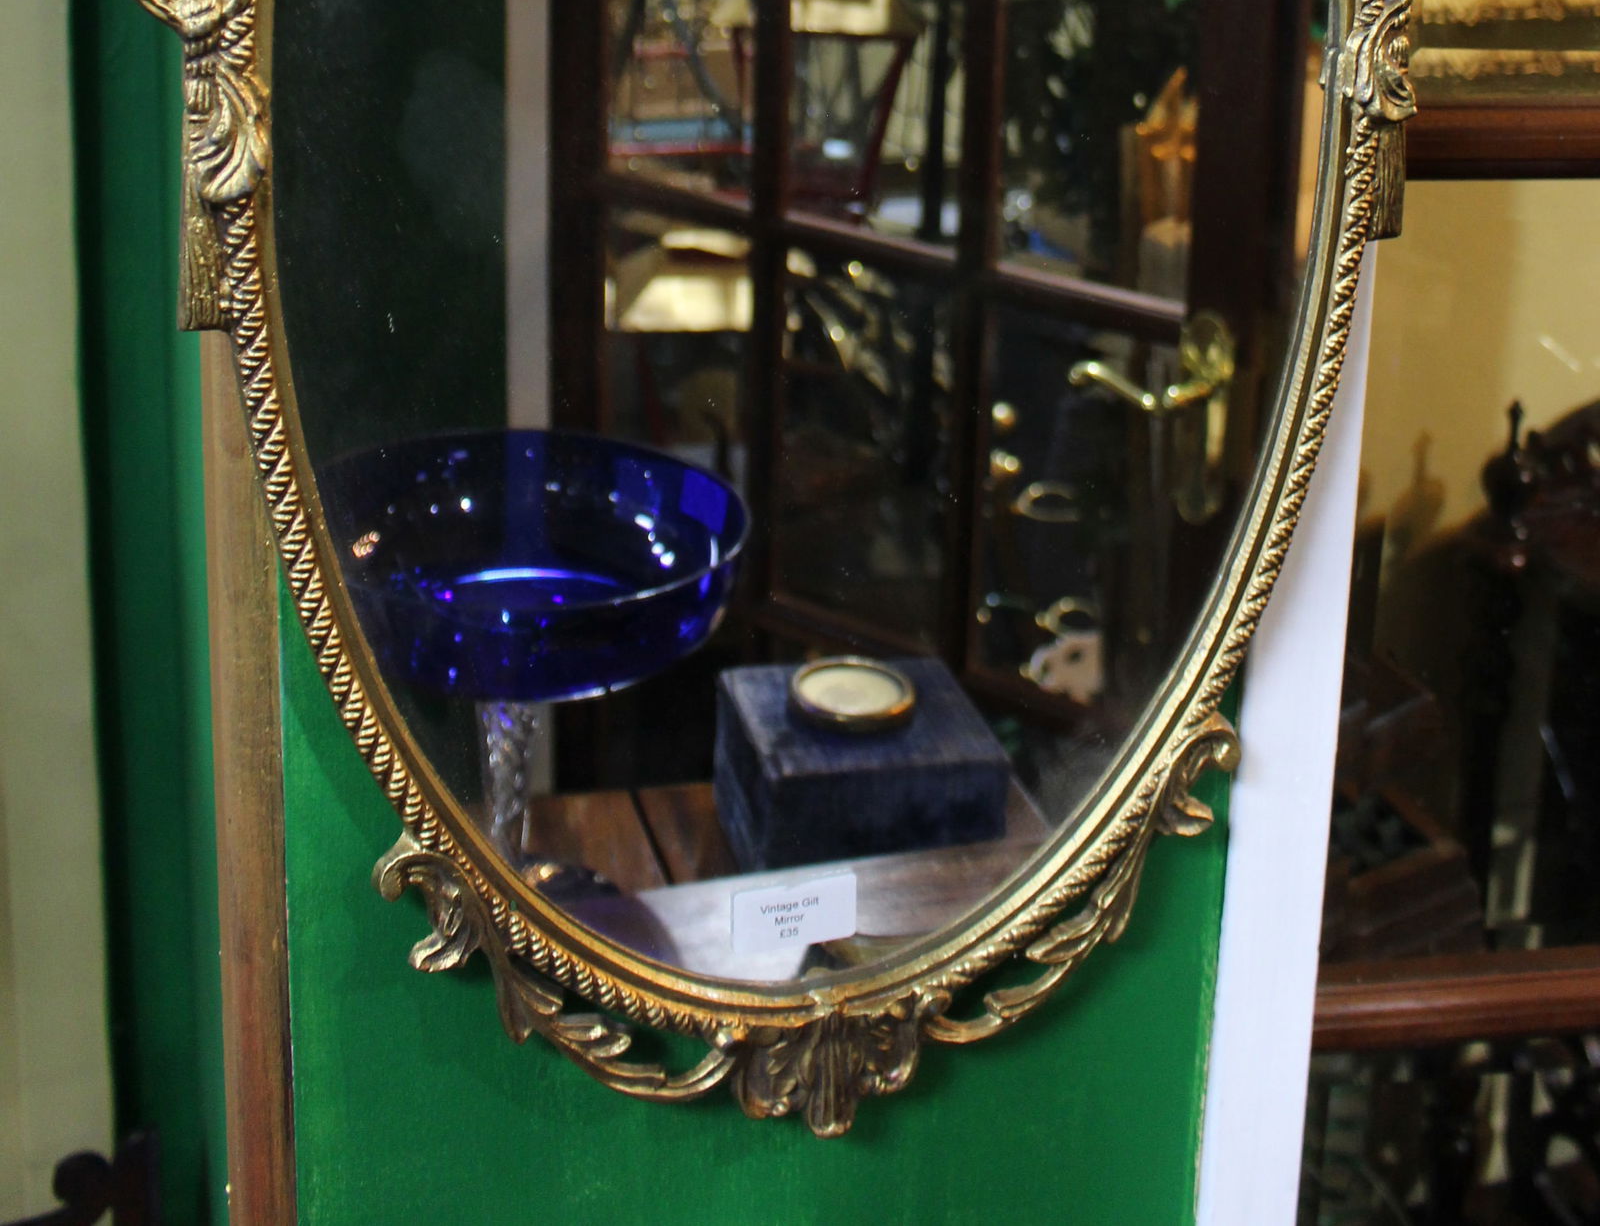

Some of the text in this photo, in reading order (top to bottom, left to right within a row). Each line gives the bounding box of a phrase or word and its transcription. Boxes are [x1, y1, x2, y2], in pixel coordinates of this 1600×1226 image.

[760, 901, 799, 914] Vintage
[774, 913, 804, 926] Mirror
[779, 927, 799, 938] £35
